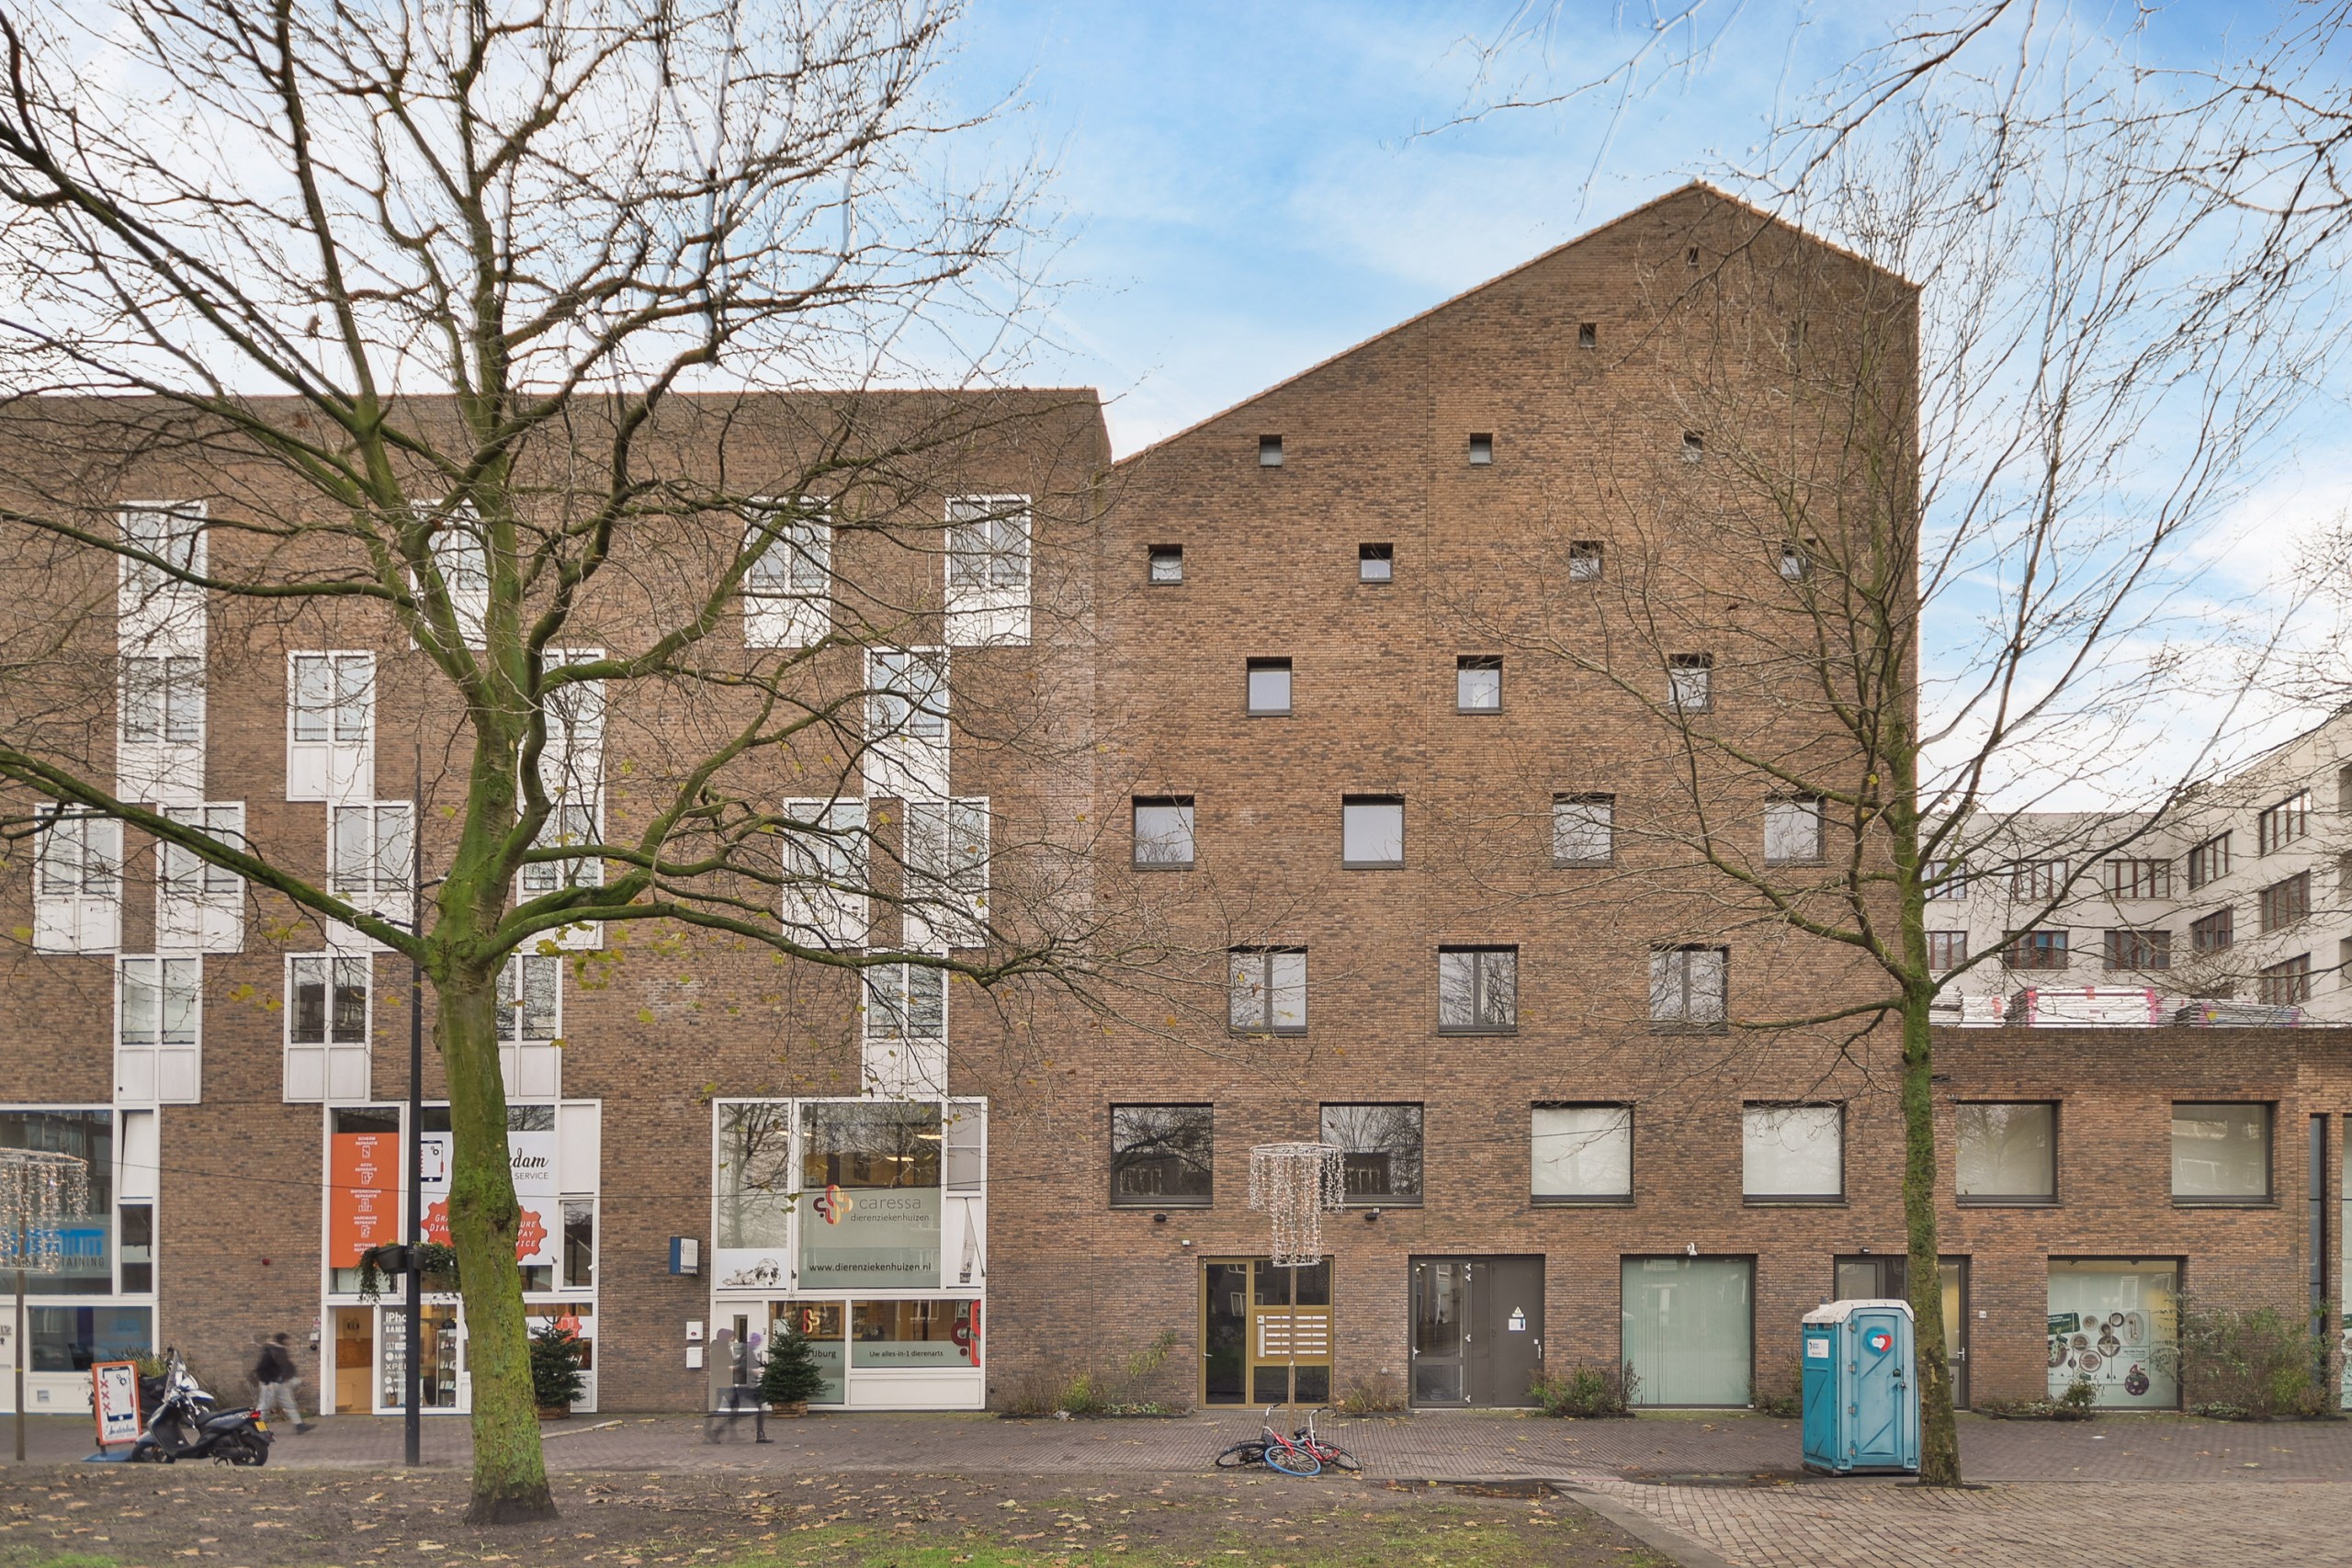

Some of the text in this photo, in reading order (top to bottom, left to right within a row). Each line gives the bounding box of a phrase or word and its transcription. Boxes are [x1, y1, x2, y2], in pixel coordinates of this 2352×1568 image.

[859, 1197, 922, 1209] caressa
[851, 1213, 930, 1222] dierenziekenhuizen
[517, 1229, 534, 1237] PAY
[809, 1262, 932, 1271] www.dierenziekenhuizen.nl
[911, 1348, 944, 1357] dierenarts
